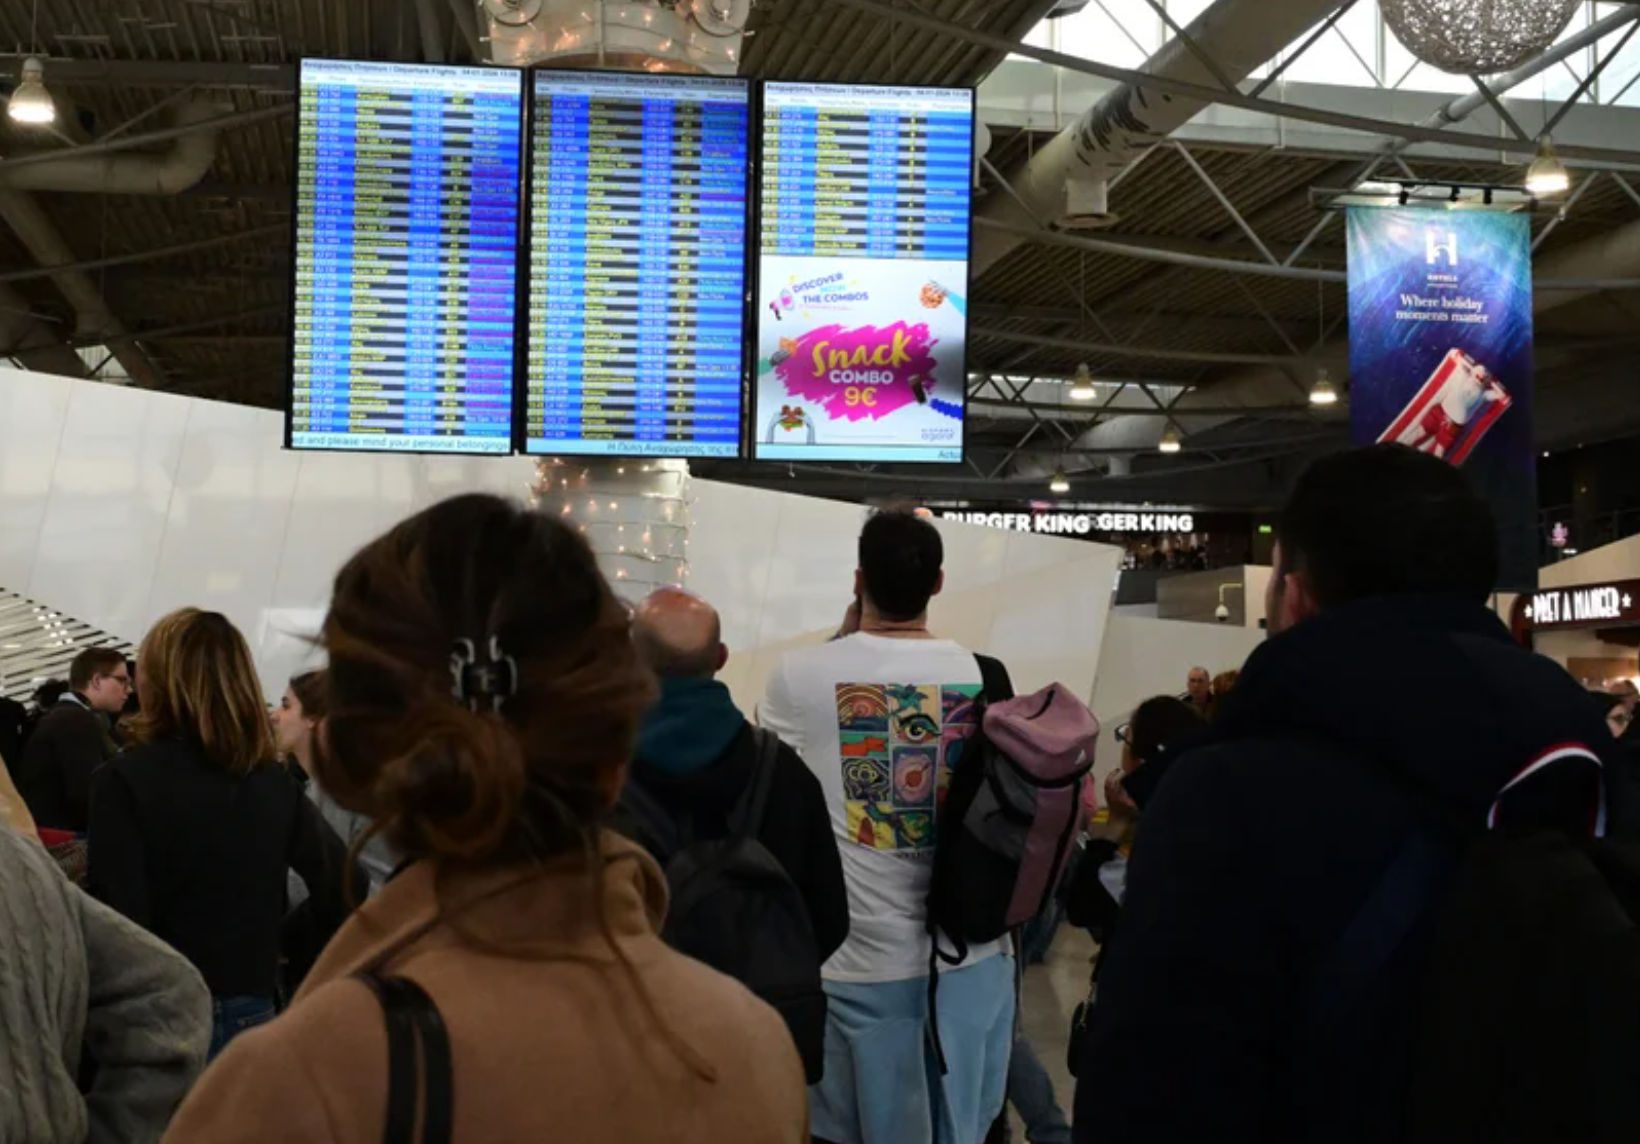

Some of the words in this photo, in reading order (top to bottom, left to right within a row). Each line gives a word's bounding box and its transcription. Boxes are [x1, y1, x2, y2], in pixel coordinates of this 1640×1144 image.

[792, 272, 844, 294] DISCOVER
[803, 295, 821, 304] THE
[824, 291, 869, 304] COMBOS
[1400, 294, 1439, 308] Where
[1441, 296, 1484, 313] holiday
[1396, 310, 1449, 322] moments
[1451, 313, 1489, 324] matter
[812, 328, 913, 378] Snack
[829, 370, 895, 385] COMBO
[844, 386, 878, 408] 9€
[307, 436, 325, 447] and
[328, 436, 360, 448] please
[362, 437, 387, 447] mind
[388, 438, 410, 449] your
[412, 438, 455, 450] personal
[1034, 513, 1090, 534] KING
[1141, 513, 1193, 532] KING
